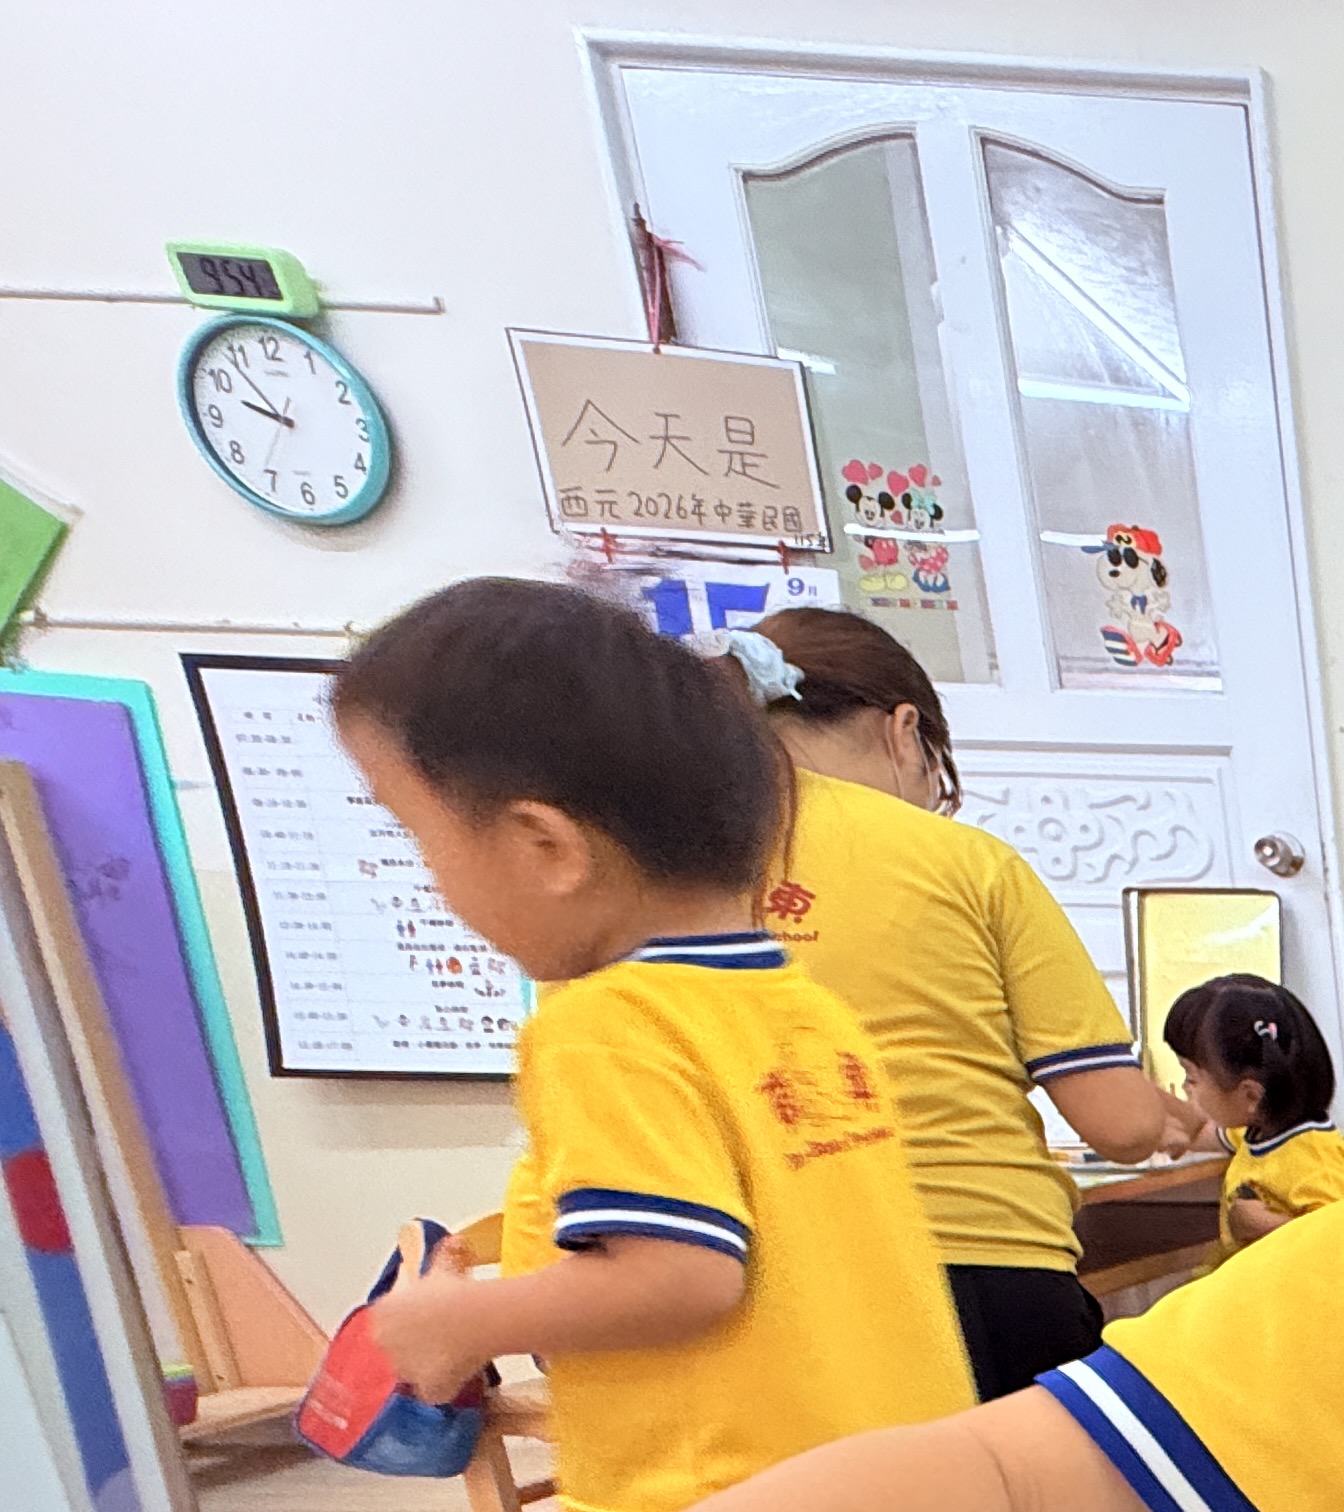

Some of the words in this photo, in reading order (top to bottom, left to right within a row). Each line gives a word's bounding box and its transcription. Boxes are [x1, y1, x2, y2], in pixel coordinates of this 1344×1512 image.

[258, 336, 284, 361] 12
[303, 350, 316, 374] 1
[208, 368, 232, 394] 10
[335, 380, 351, 405] 2
[208, 404, 224, 428] 9
[355, 417, 370, 443] 3
[229, 440, 244, 465] 8
[561, 398, 782, 490] 今天是
[354, 452, 367, 475] 4
[264, 469, 277, 492] 7
[334, 475, 349, 499] 5
[301, 482, 315, 505] 6
